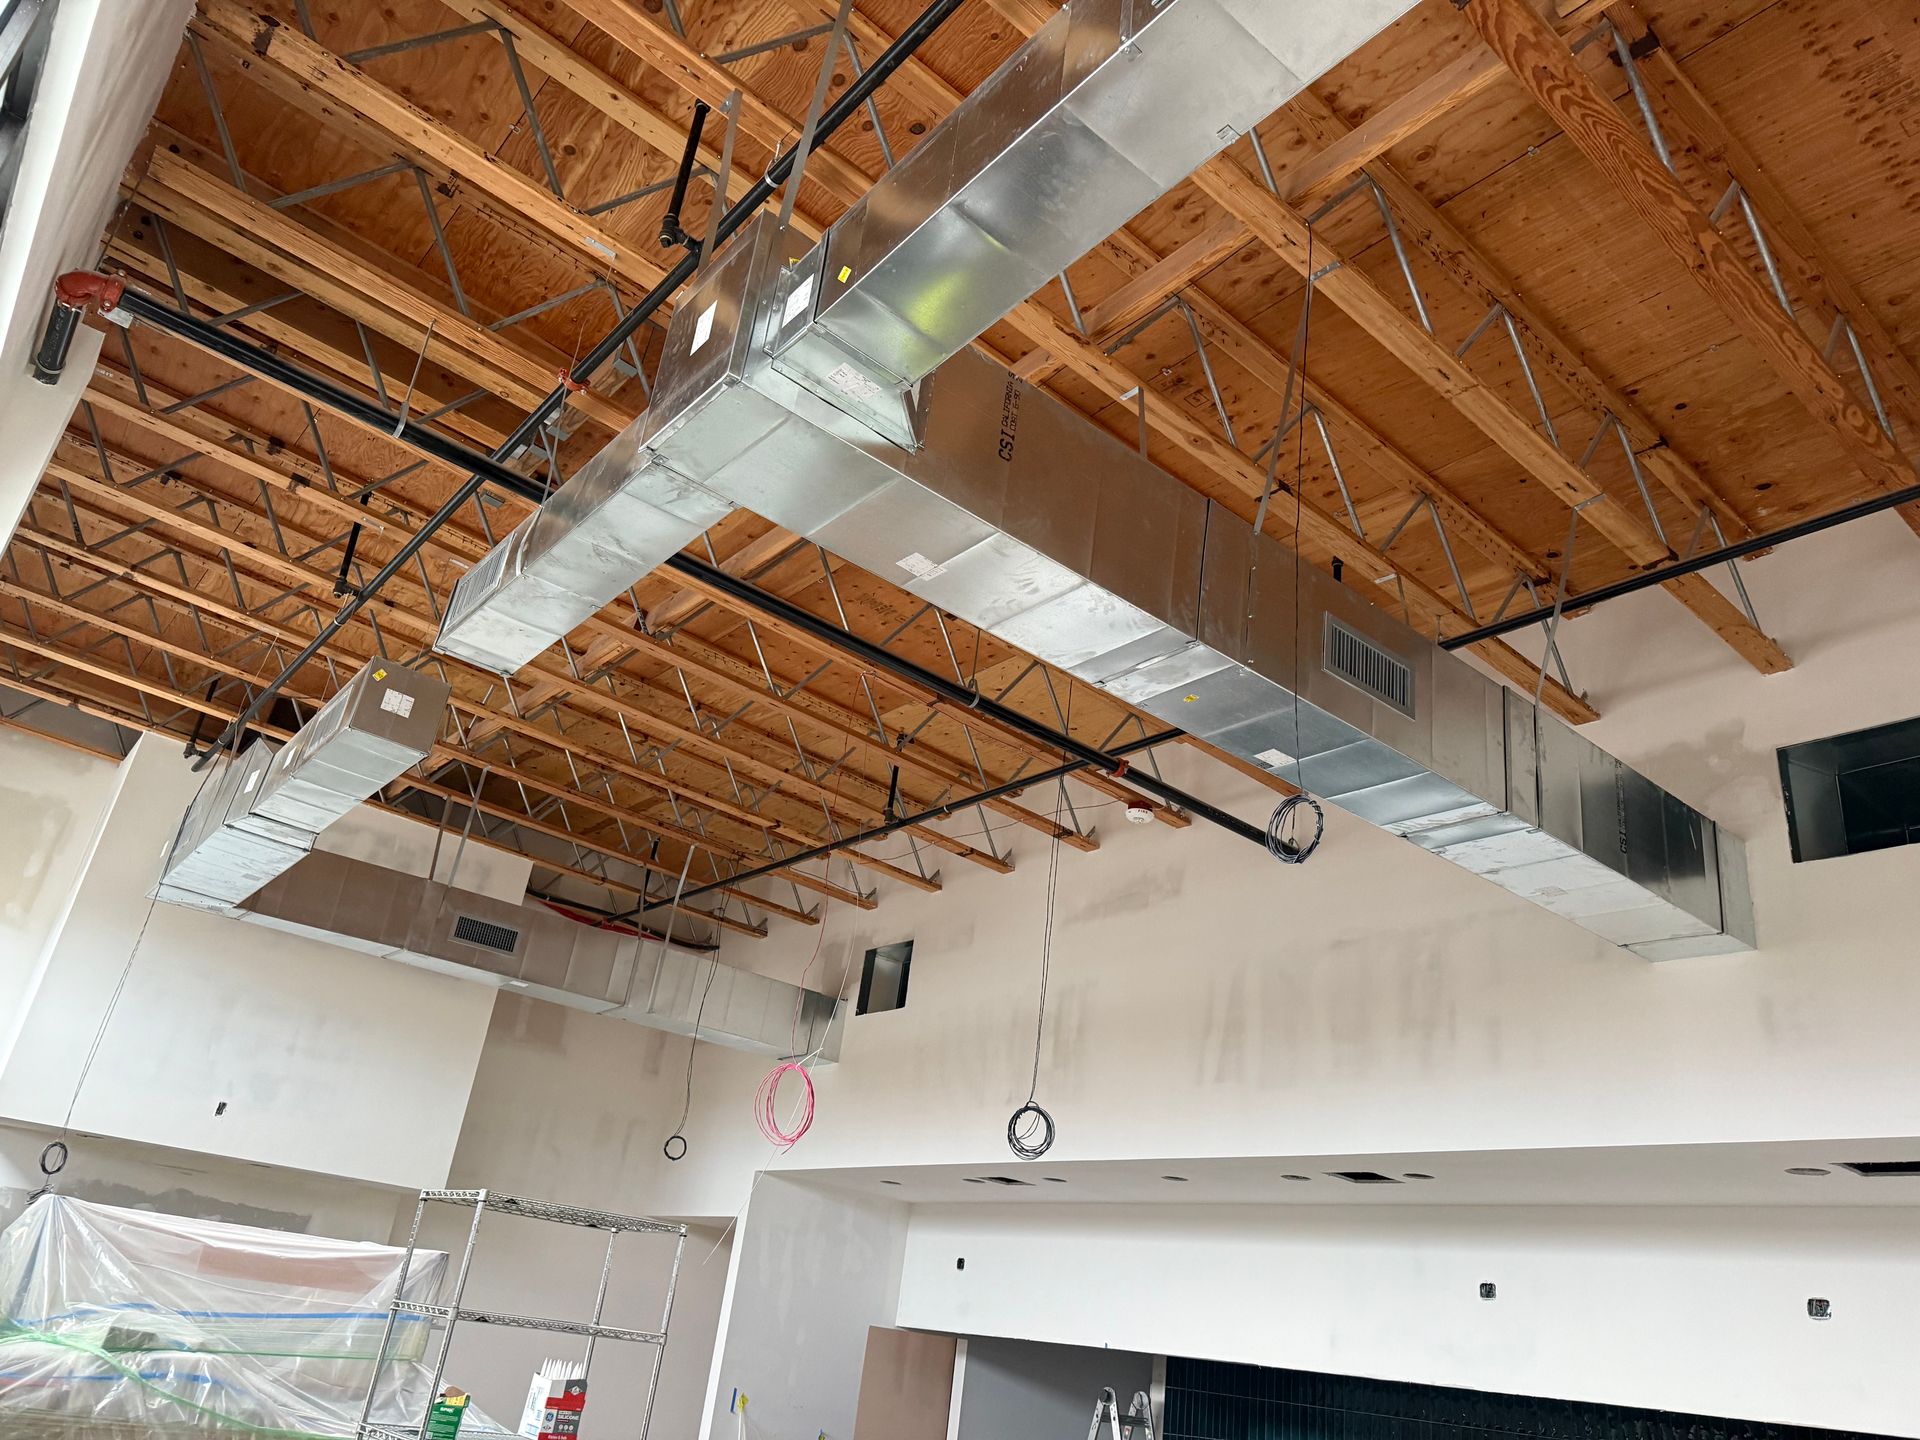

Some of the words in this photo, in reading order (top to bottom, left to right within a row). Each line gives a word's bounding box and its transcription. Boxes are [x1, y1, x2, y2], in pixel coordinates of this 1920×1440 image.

[1001, 381, 1013, 427] CALIFORNIA
[998, 429, 1015, 462] CSI
[1619, 830, 1628, 855] CSI
